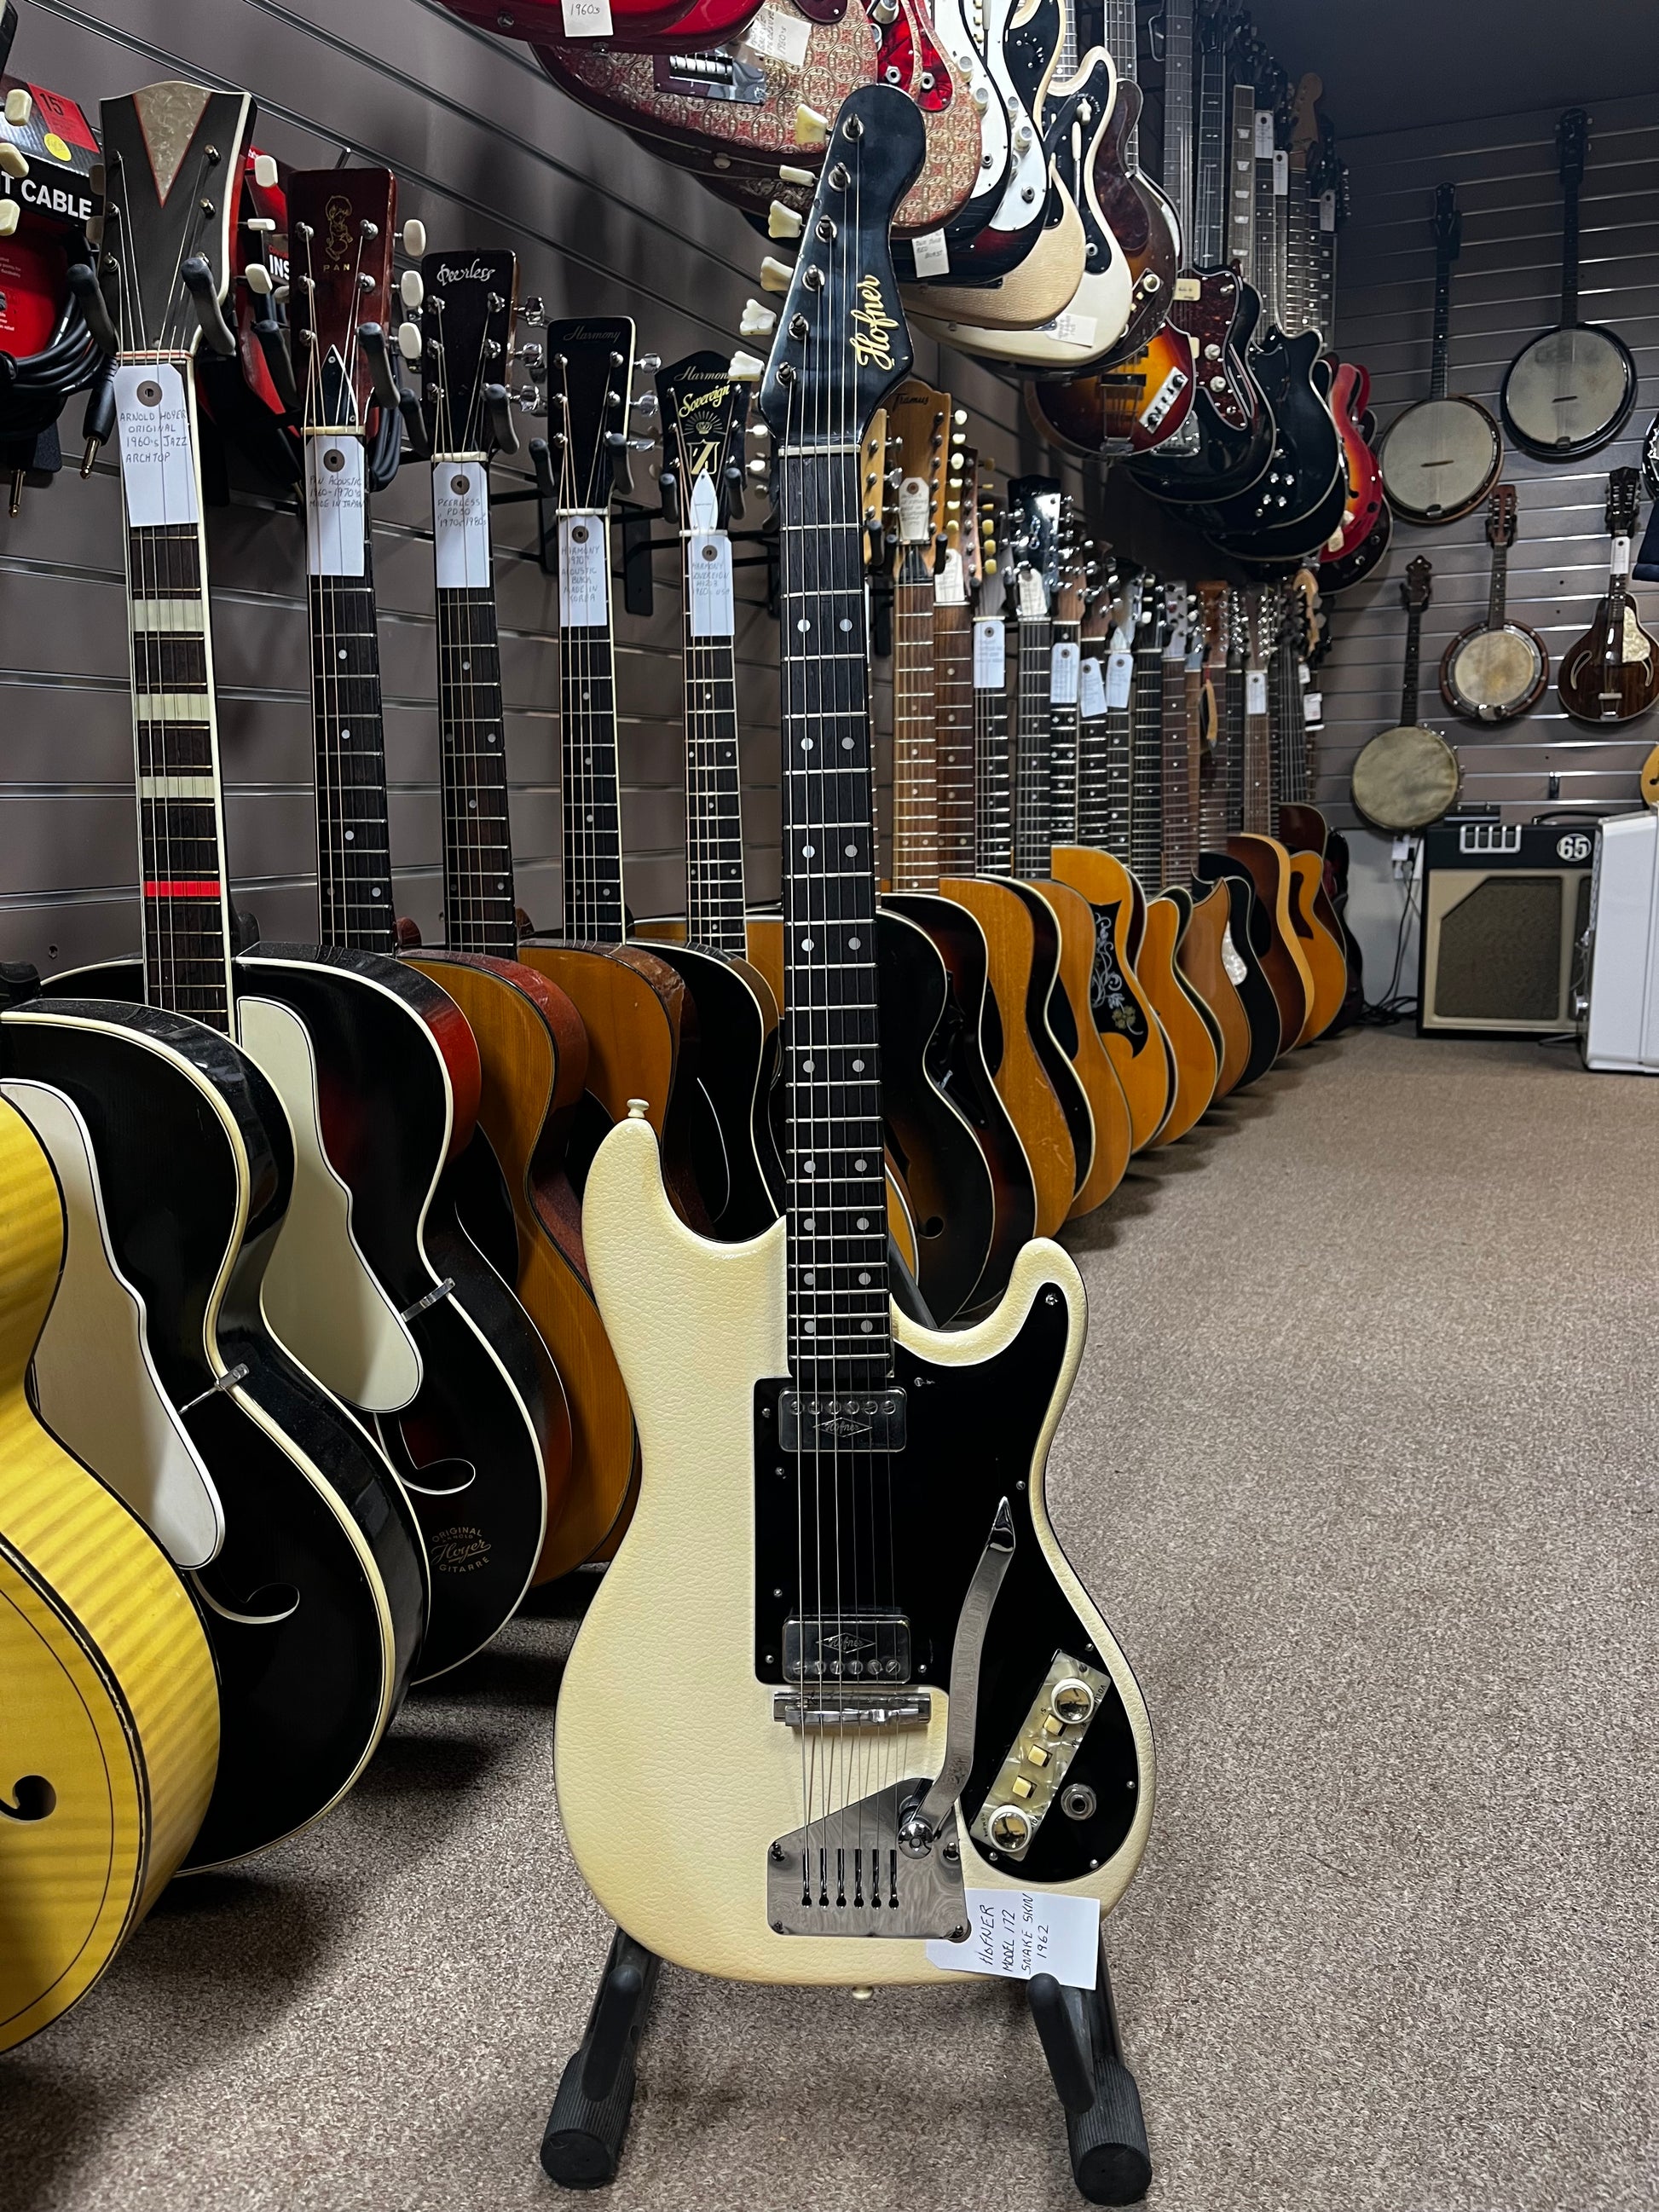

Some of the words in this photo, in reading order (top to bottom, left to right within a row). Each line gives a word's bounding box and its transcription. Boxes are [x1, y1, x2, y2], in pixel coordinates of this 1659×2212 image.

[21, 179, 92, 221] CABLE
[323, 263, 350, 272] PAN
[436, 258, 496, 286] Peerless
[563, 325, 621, 344] Harmony
[674, 366, 730, 382] Harmon
[679, 381, 731, 418] Sovereign
[119, 412, 155, 422] ARNOLD
[160, 409, 186, 419] HOYER
[128, 423, 176, 433] ORIGINAL
[163, 435, 188, 447] JAZZ
[328, 475, 362, 486] ACOUSTIC
[310, 488, 361, 497] 160-1970's
[342, 500, 364, 508] JAPAN
[437, 498, 481, 506] PEERLESS
[561, 567, 598, 576] AOUSTIC
[1559, 835, 1587, 859] 65
[431, 1527, 483, 1543] ORIGINAL
[431, 1539, 492, 1566] Hoyer
[438, 1556, 490, 1574] GITARRE
[1022, 1892, 1034, 1924] SKIN
[1002, 1909, 1015, 1933] 172
[975, 1903, 995, 1966] HOFNER
[1037, 1924, 1049, 1959] 1962
[1002, 1939, 1015, 1972] MODEL
[1021, 1929, 1033, 1975] SNAKE
